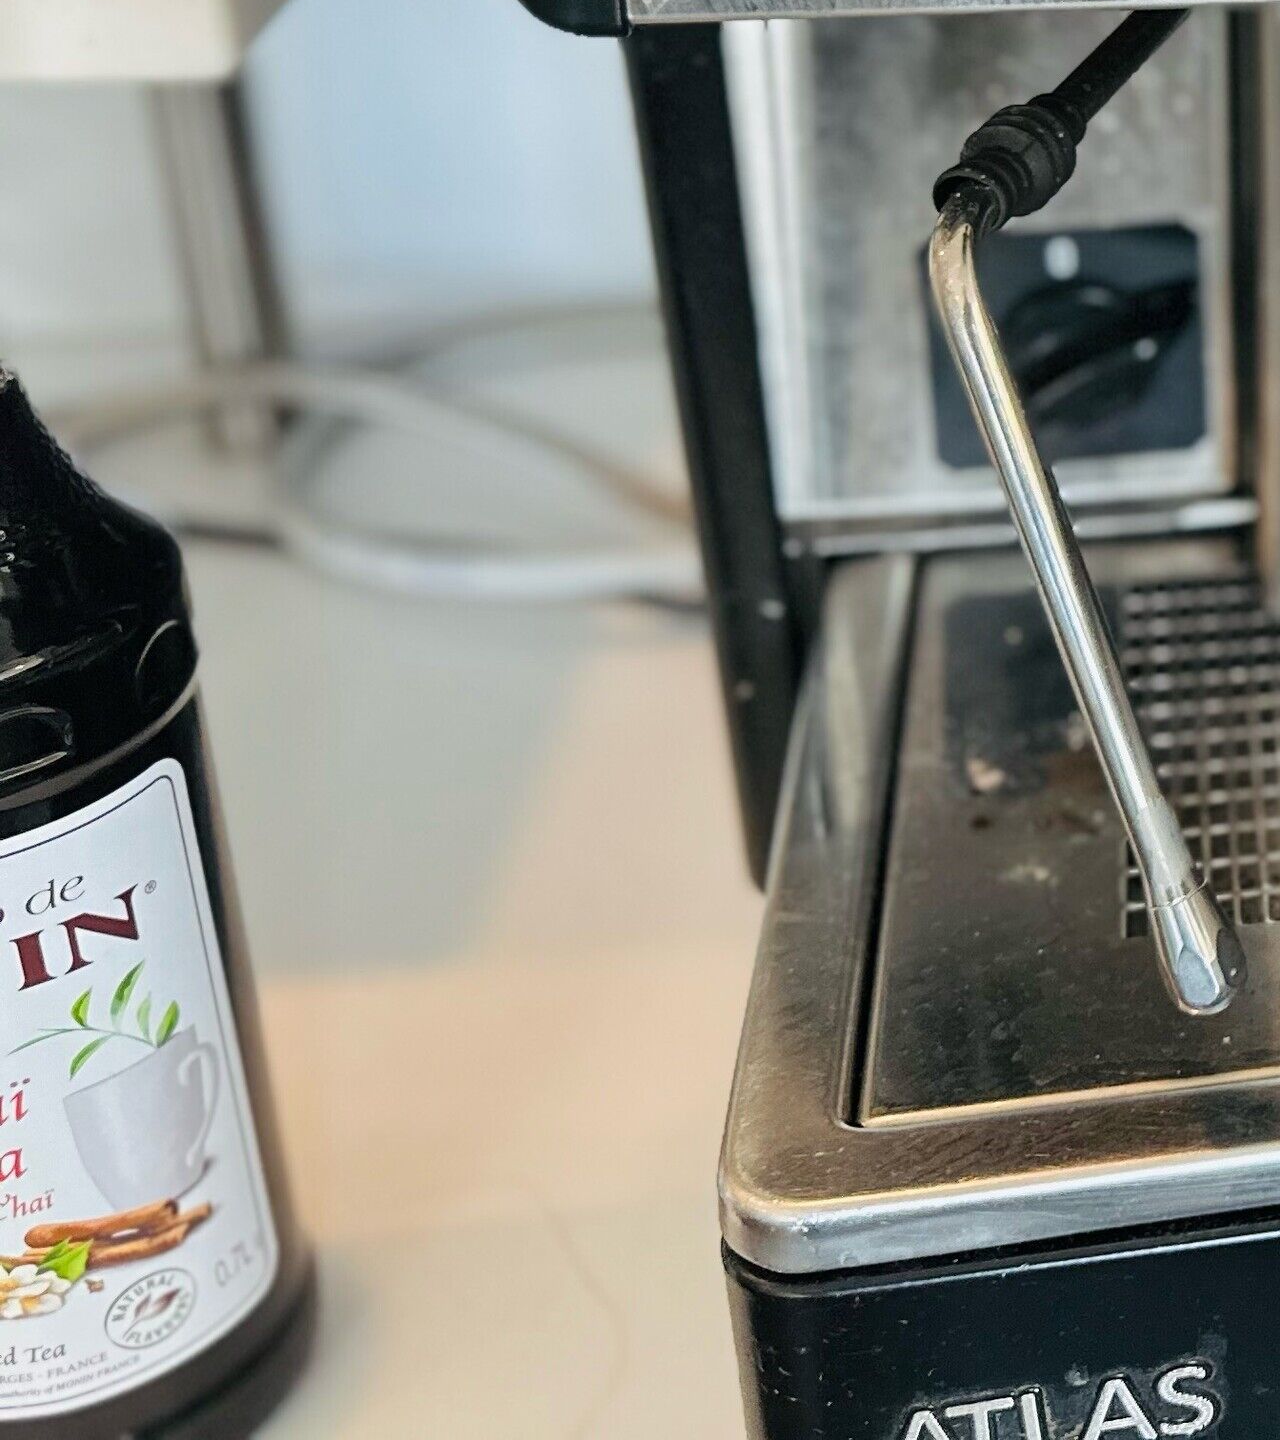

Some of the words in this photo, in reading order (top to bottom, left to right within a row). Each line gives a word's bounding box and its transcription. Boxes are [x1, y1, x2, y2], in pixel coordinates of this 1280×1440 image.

[25, 874, 85, 916] de
[0, 1345, 17, 1366] d
[23, 1343, 66, 1363] Tea
[47, 1352, 108, 1379] FRANCE
